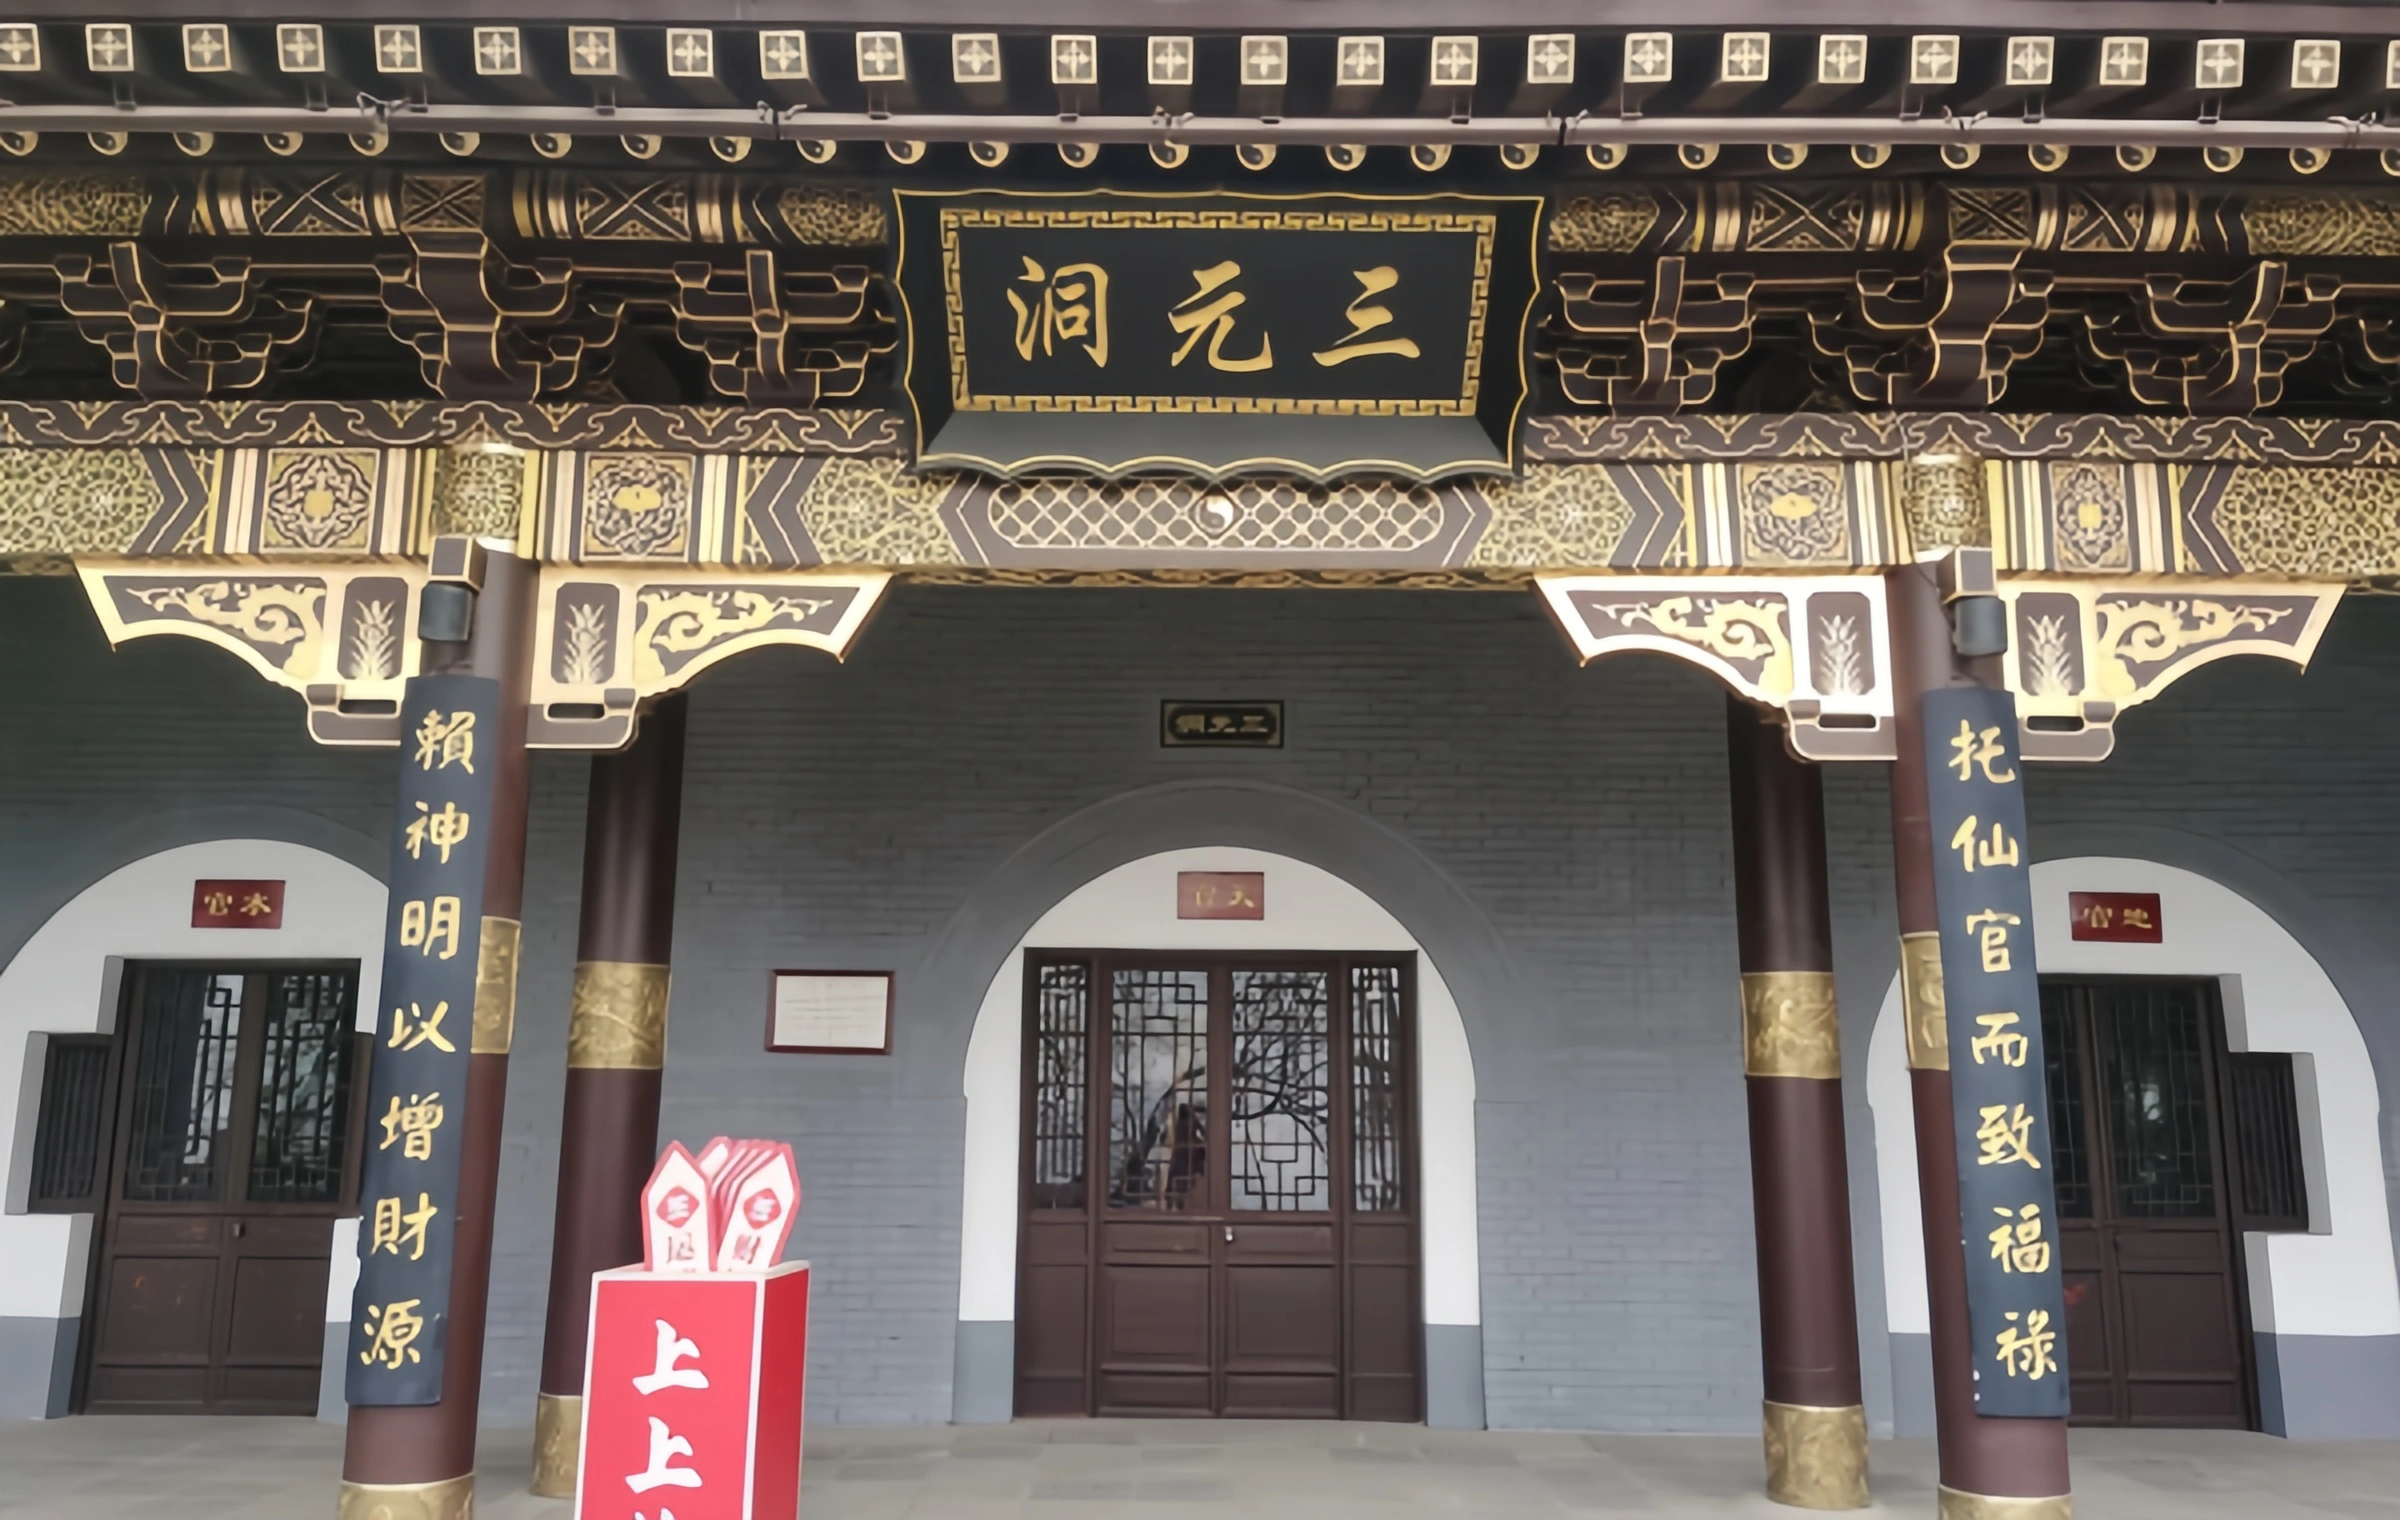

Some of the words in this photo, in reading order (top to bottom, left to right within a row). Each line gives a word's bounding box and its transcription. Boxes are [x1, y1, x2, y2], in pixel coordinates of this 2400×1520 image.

[1006, 255, 1421, 372] 三元洞
[625, 1318, 710, 1520] 上上
